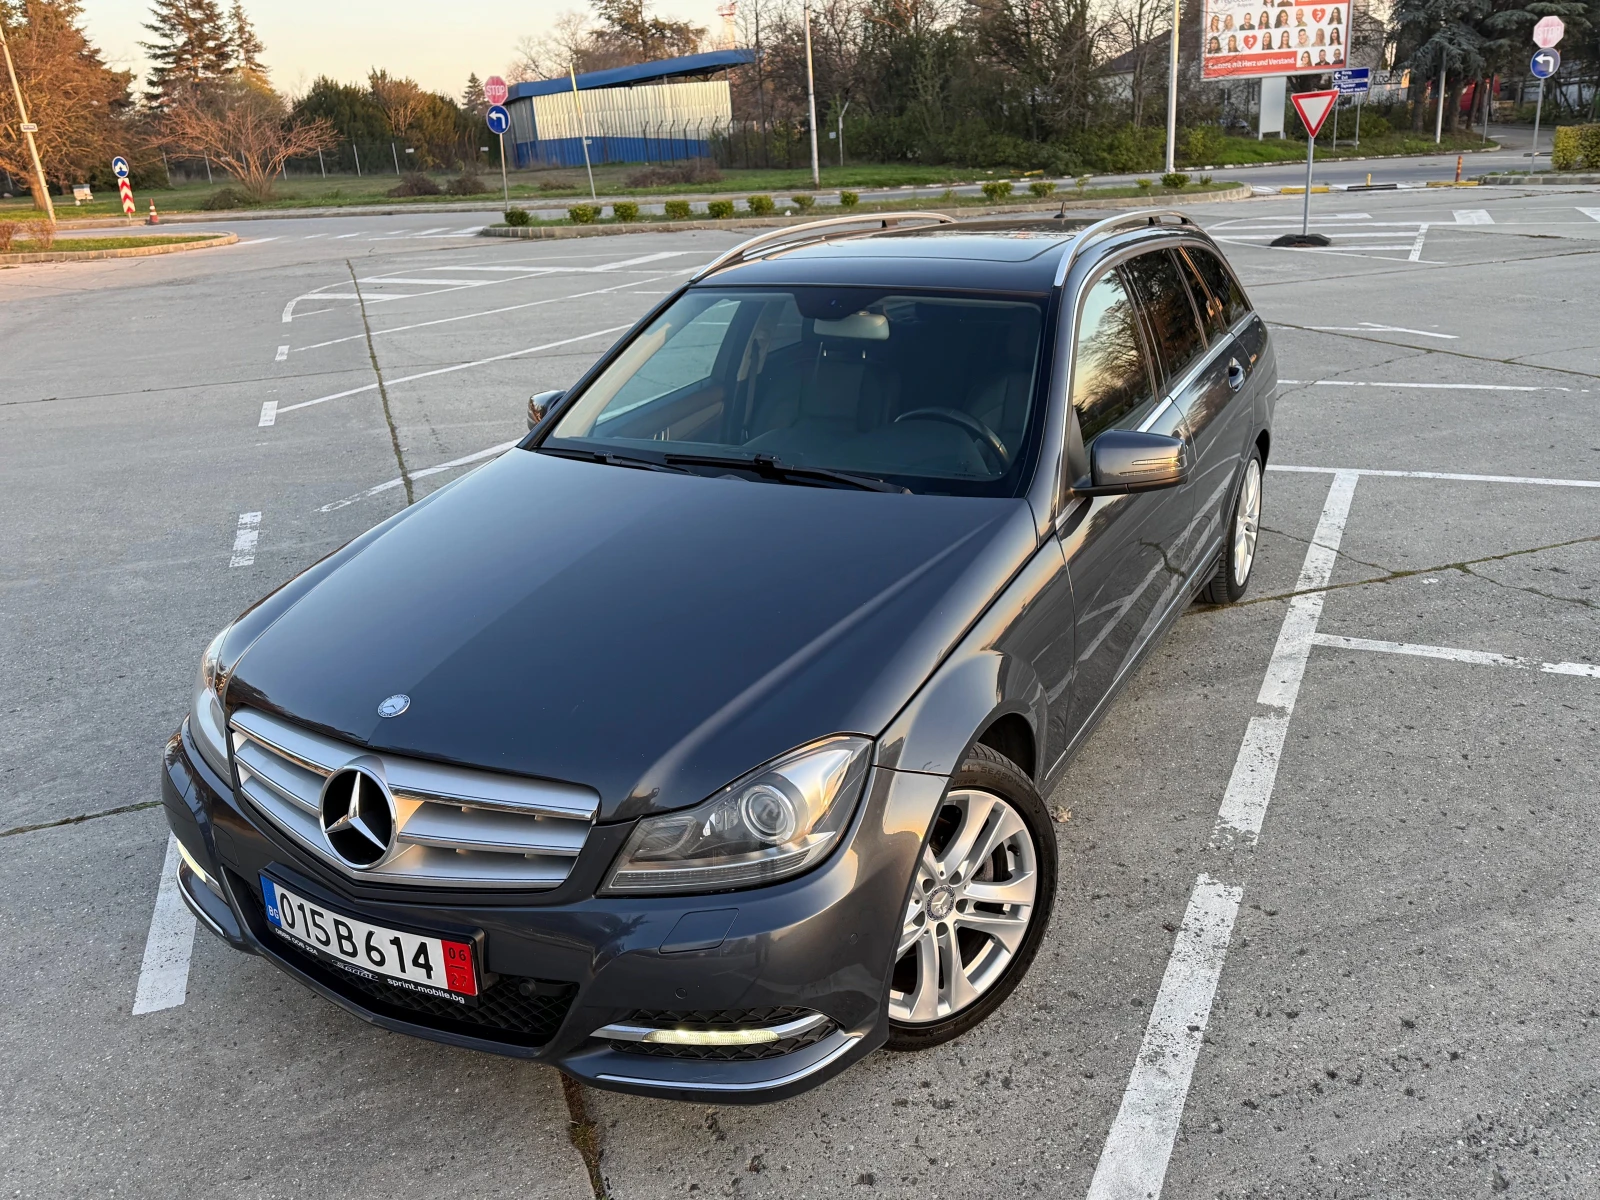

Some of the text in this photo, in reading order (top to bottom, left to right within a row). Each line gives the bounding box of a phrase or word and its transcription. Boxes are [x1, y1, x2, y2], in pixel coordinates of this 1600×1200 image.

[1315, 11, 1322, 21] ?
[1537, 26, 1561, 38] STOP
[1247, 37, 1254, 47] ?
[1242, 59, 1257, 67] Herz
[1257, 58, 1269, 66] und
[1268, 56, 1295, 65] Verstand.
[486, 85, 505, 96] STOP
[267, 904, 280, 920] BG
[279, 892, 434, 980] 015B614
[448, 947, 467, 962] 06
[450, 972, 468, 987] 27
[386, 978, 465, 1004] sprint.mobile.bg
